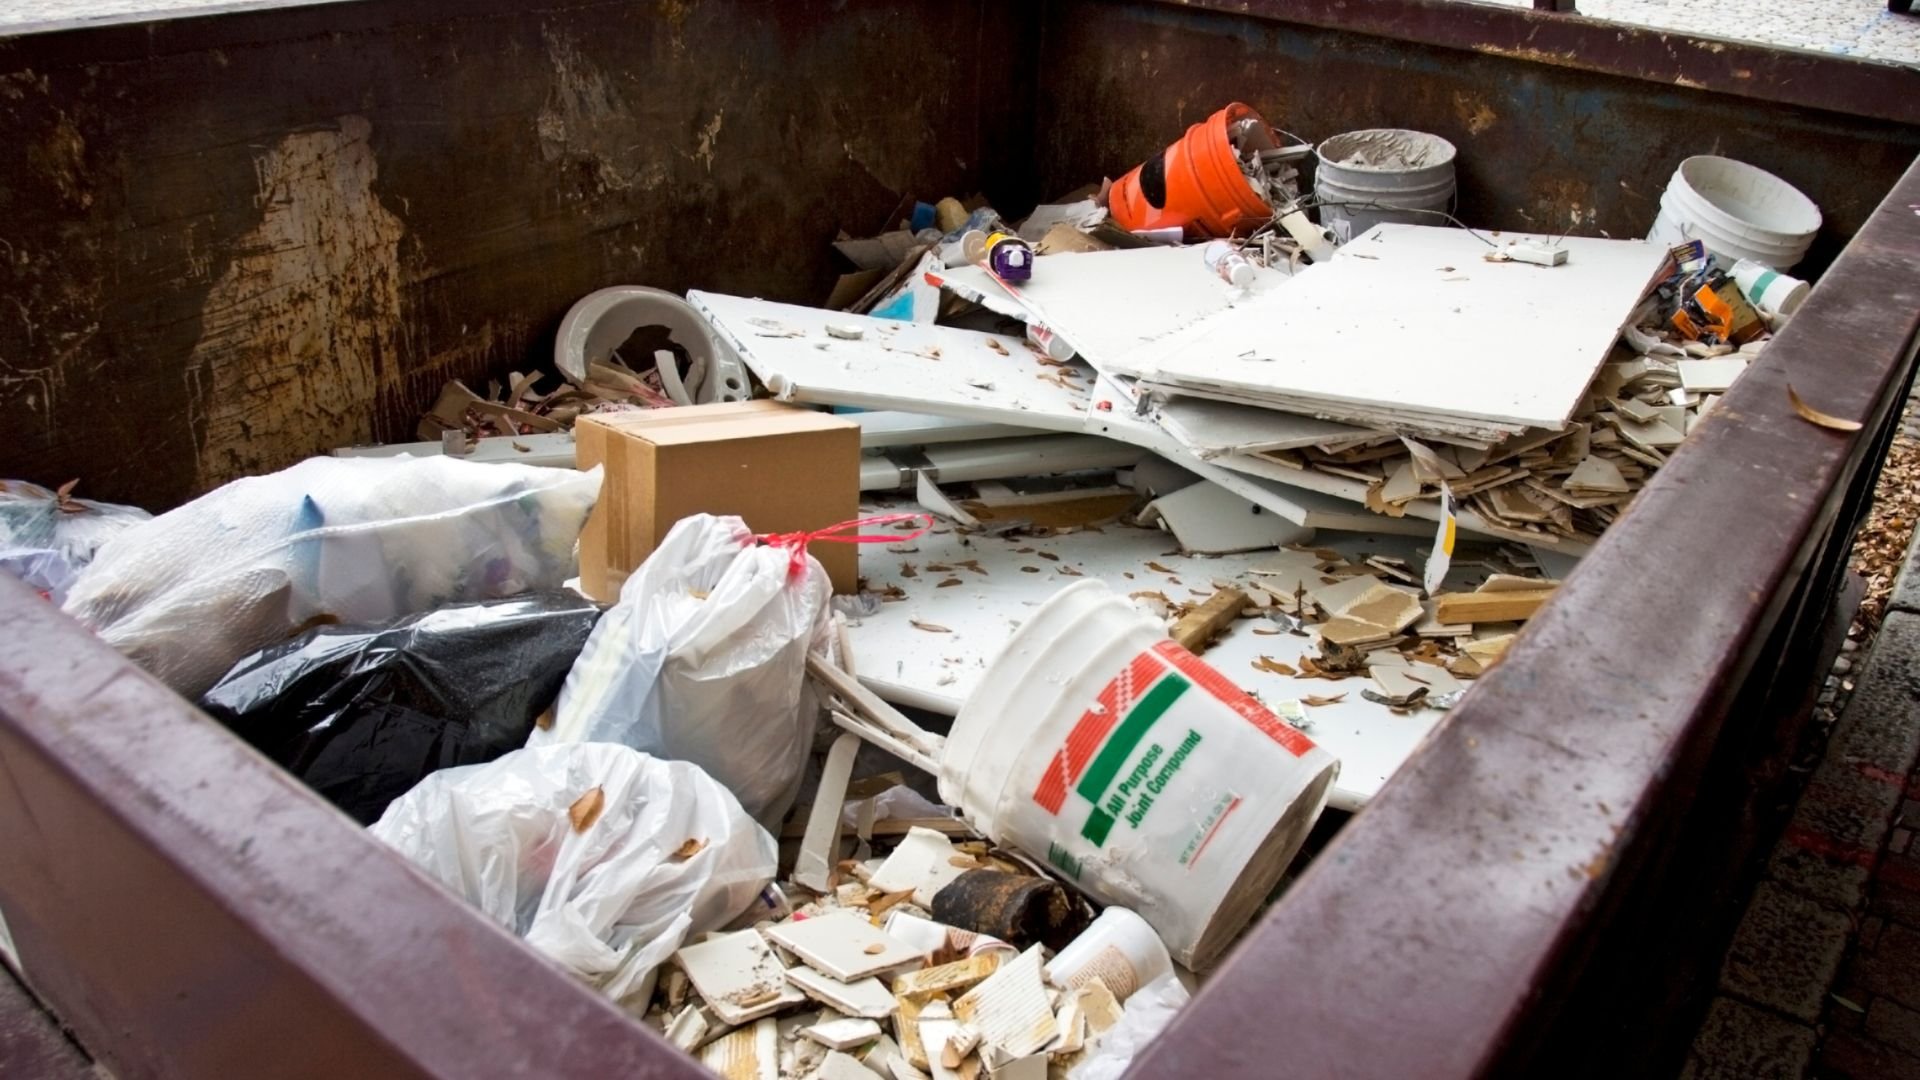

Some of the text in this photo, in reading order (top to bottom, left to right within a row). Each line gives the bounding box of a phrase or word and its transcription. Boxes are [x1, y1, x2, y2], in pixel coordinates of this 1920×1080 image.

[1106, 743, 1163, 817] All Purpose
[1125, 728, 1203, 829] Joint Compound
